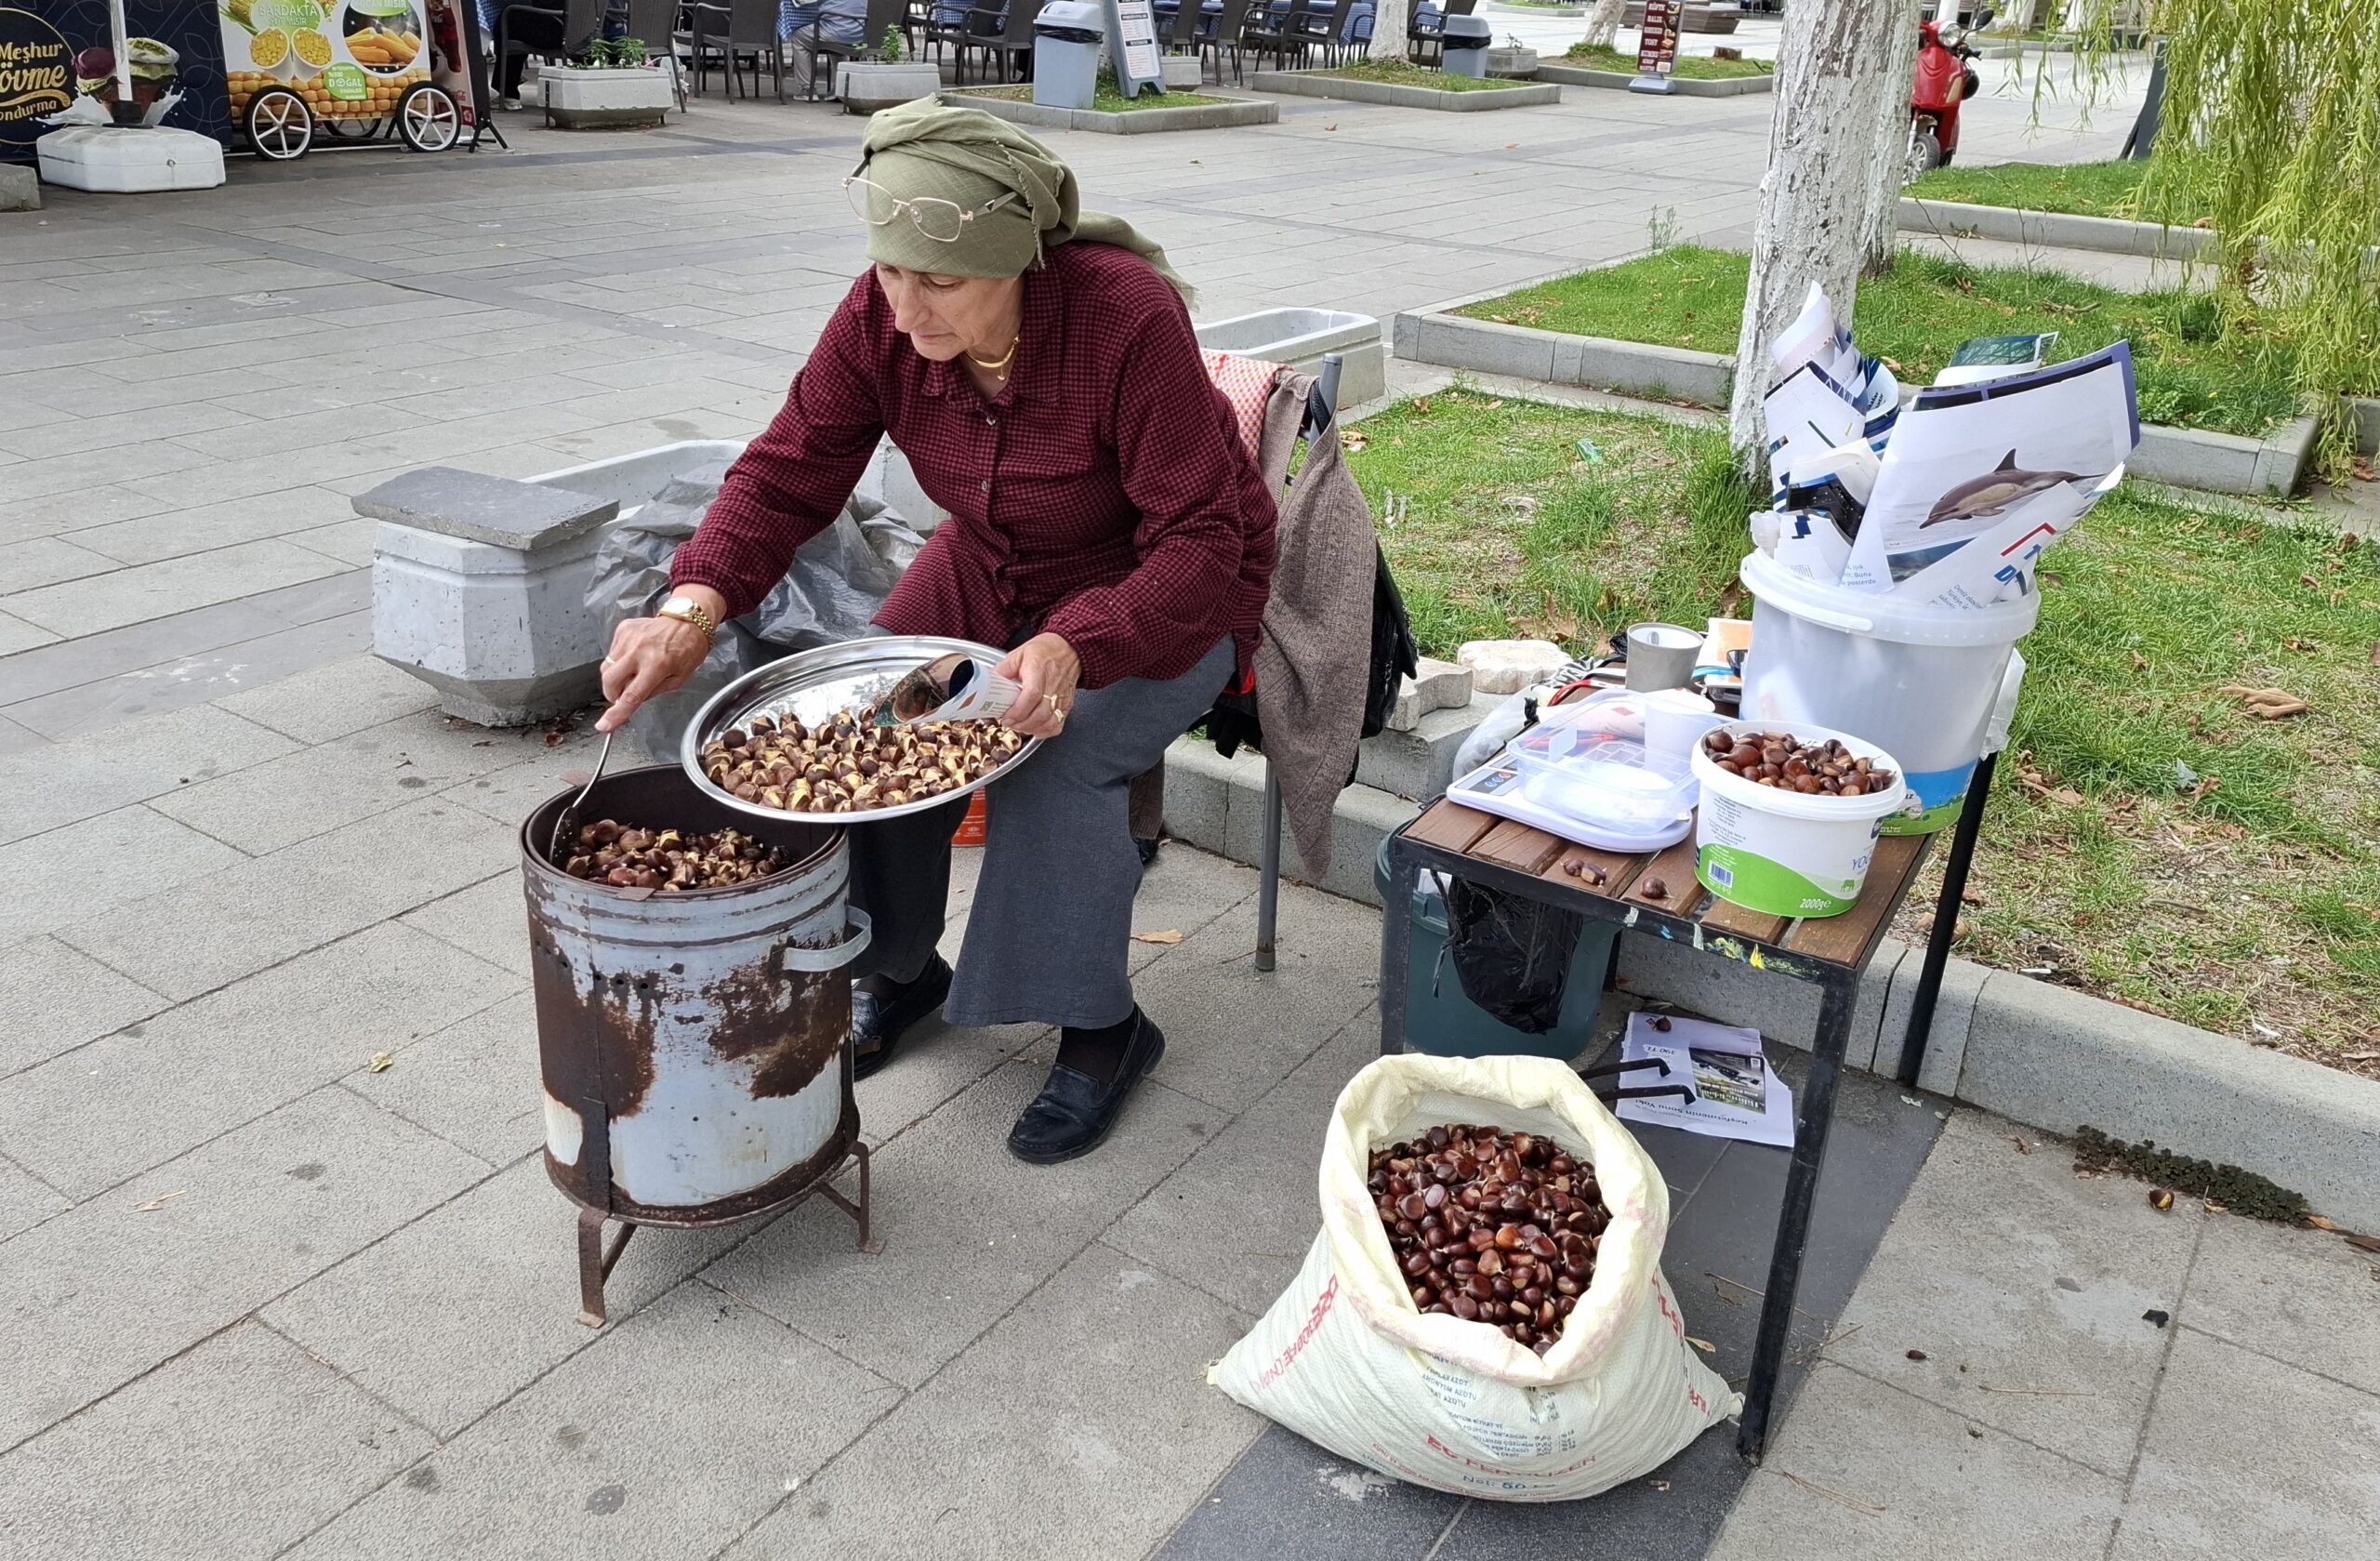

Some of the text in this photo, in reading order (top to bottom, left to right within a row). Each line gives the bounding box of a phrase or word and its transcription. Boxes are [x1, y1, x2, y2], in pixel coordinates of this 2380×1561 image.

[258, 5, 318, 17] BARDAKTA
[0, 42, 63, 64] Meşhur
[0, 61, 68, 93] övme
[0, 99, 57, 122] ondurma
[1658, 1104, 1683, 1114] Sonu
[1685, 1109, 1749, 1125] Keşfetmenin
[1450, 1377, 1468, 1386] AZOT
[1454, 1388, 1477, 1400] AZOTU
[1444, 1396, 1466, 1408] AZOTU
